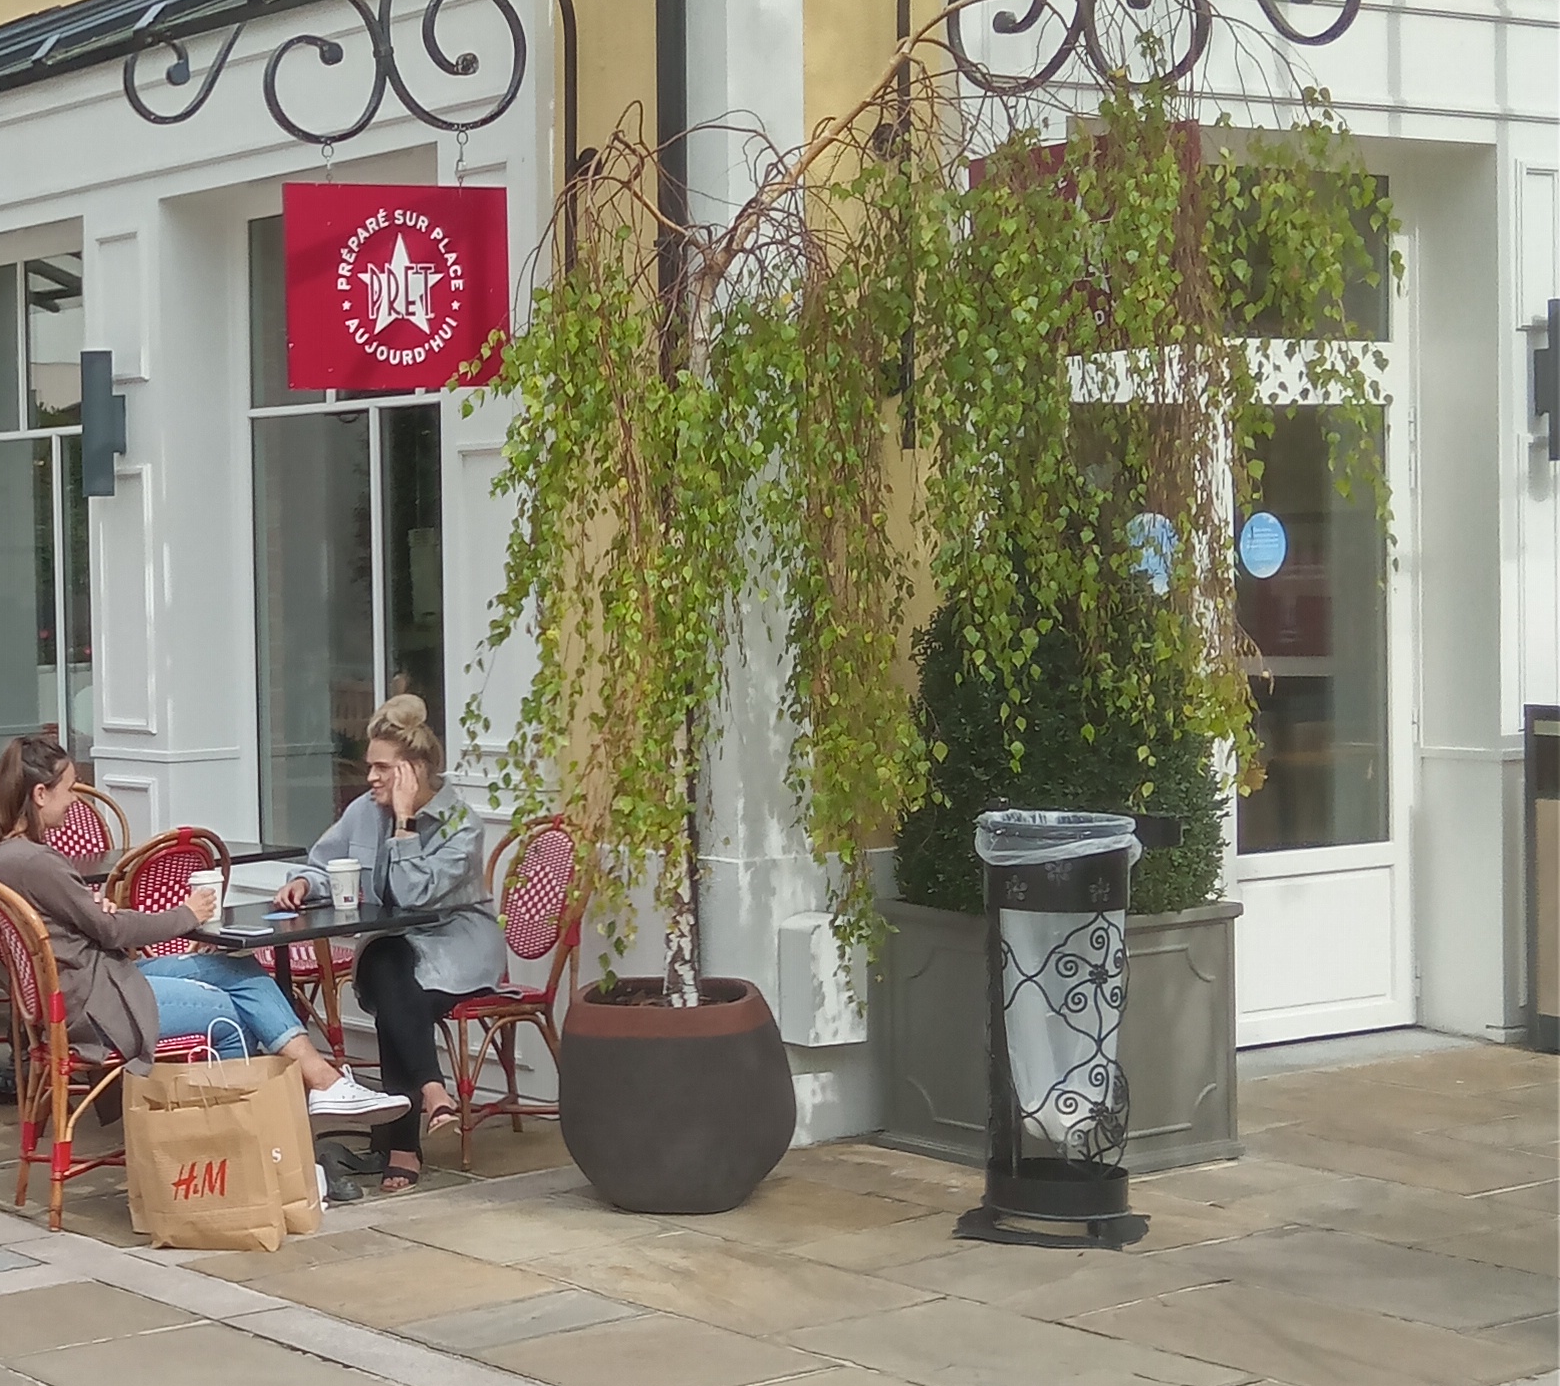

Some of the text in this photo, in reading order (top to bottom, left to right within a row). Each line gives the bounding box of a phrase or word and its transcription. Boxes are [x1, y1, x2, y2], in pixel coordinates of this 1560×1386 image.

[337, 208, 464, 291] PRÉPARÉ SUR PLACE
[367, 263, 435, 319] PRET
[345, 317, 458, 366] AUJOURD'HUI
[172, 1158, 229, 1201] H&M
